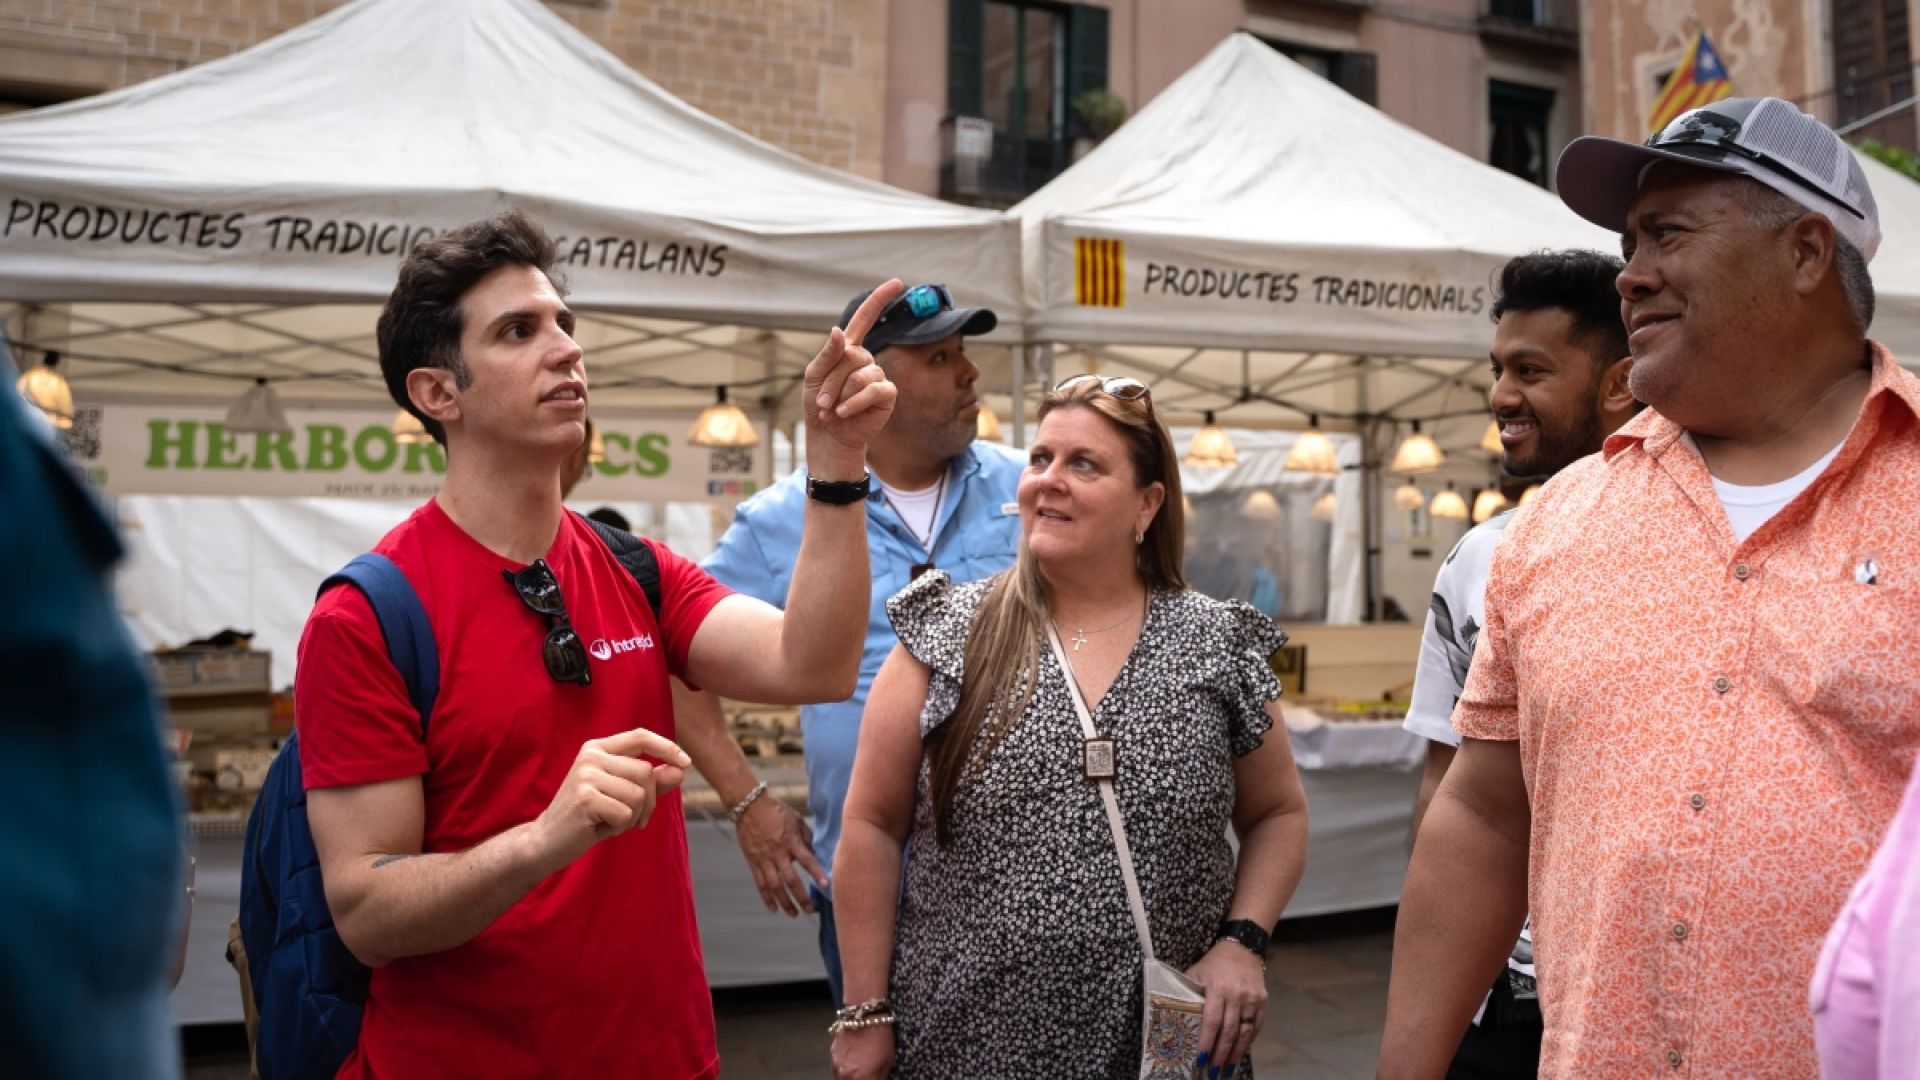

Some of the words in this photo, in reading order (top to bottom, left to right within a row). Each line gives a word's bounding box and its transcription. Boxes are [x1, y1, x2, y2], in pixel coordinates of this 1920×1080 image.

[4, 198, 245, 250] PRODUCTES
[1144, 263, 1299, 304] PRODUCTES
[1312, 276, 1485, 315] TRADICIONALS
